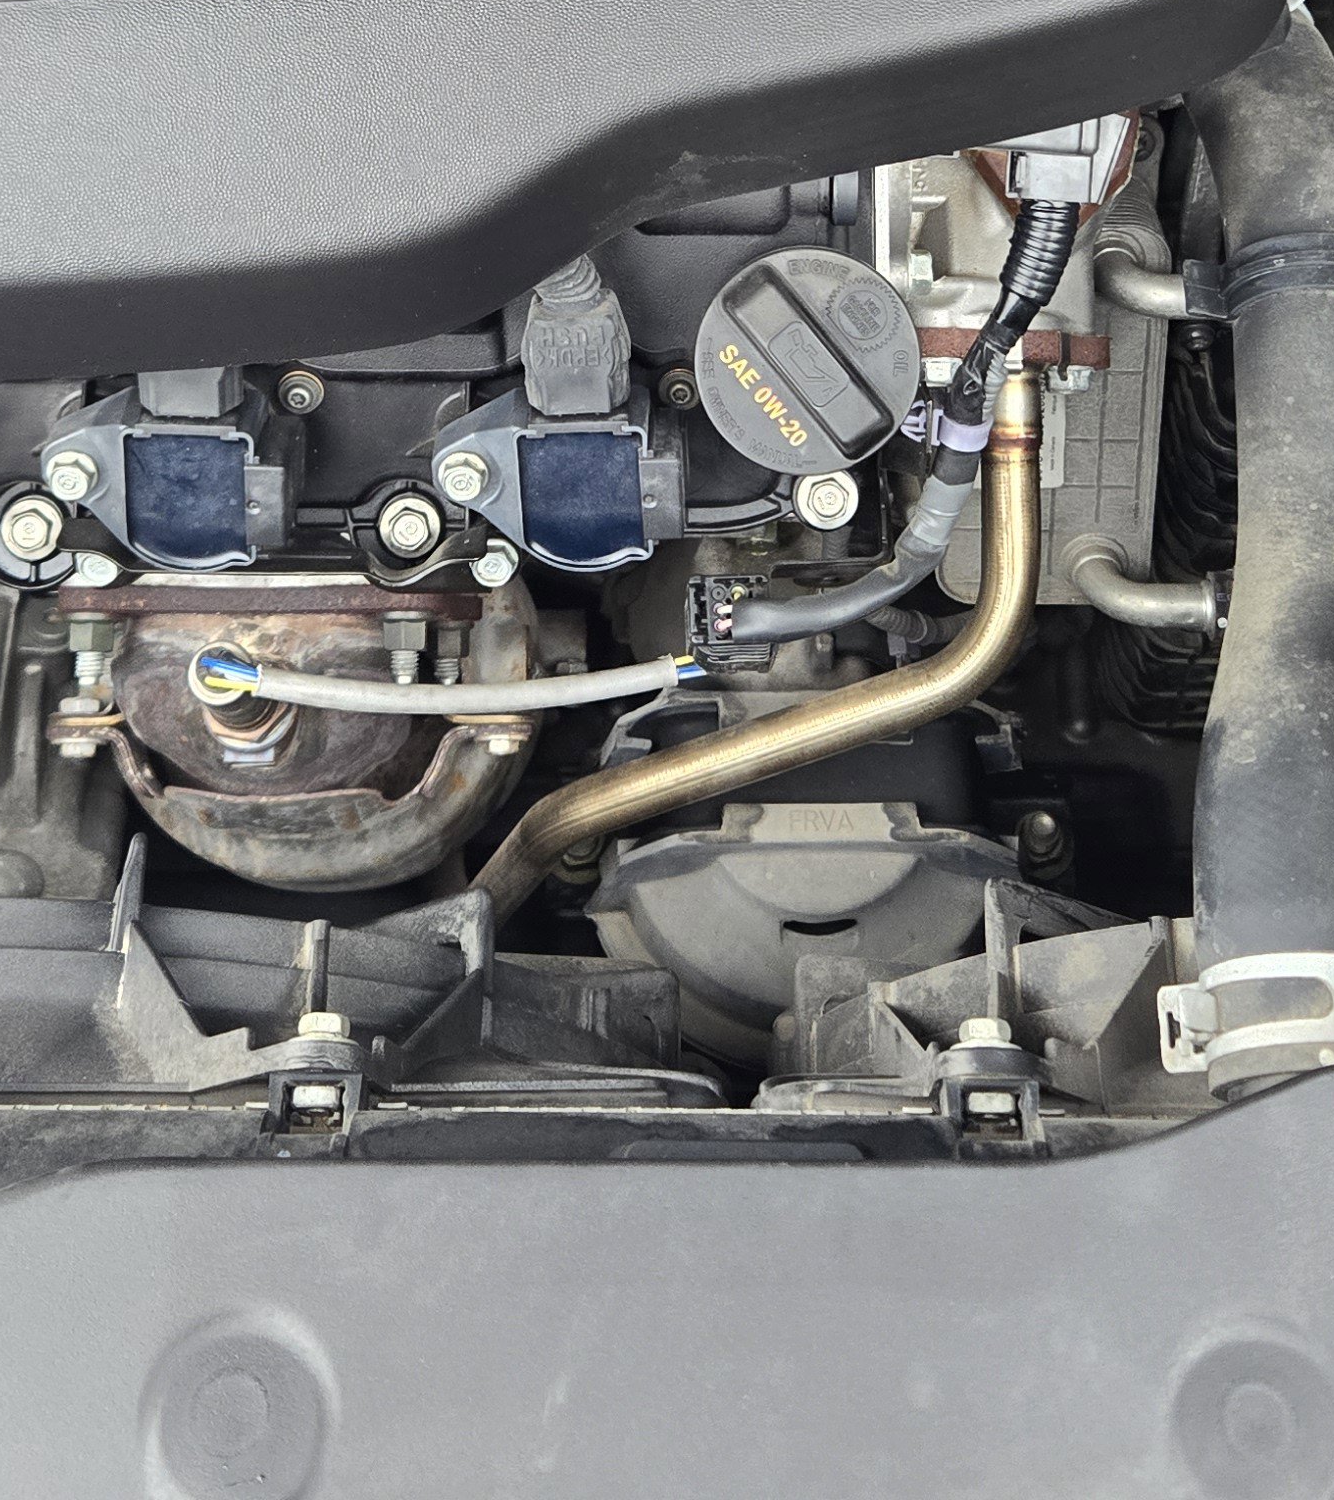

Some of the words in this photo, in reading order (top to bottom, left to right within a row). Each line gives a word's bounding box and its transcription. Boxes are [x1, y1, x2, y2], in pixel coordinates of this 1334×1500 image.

[786, 258, 850, 280] ENGINE
[892, 349, 909, 378] OIL
[719, 344, 761, 390] SAE
[753, 386, 808, 447] 0W-20
[788, 808, 855, 832] FRVA
